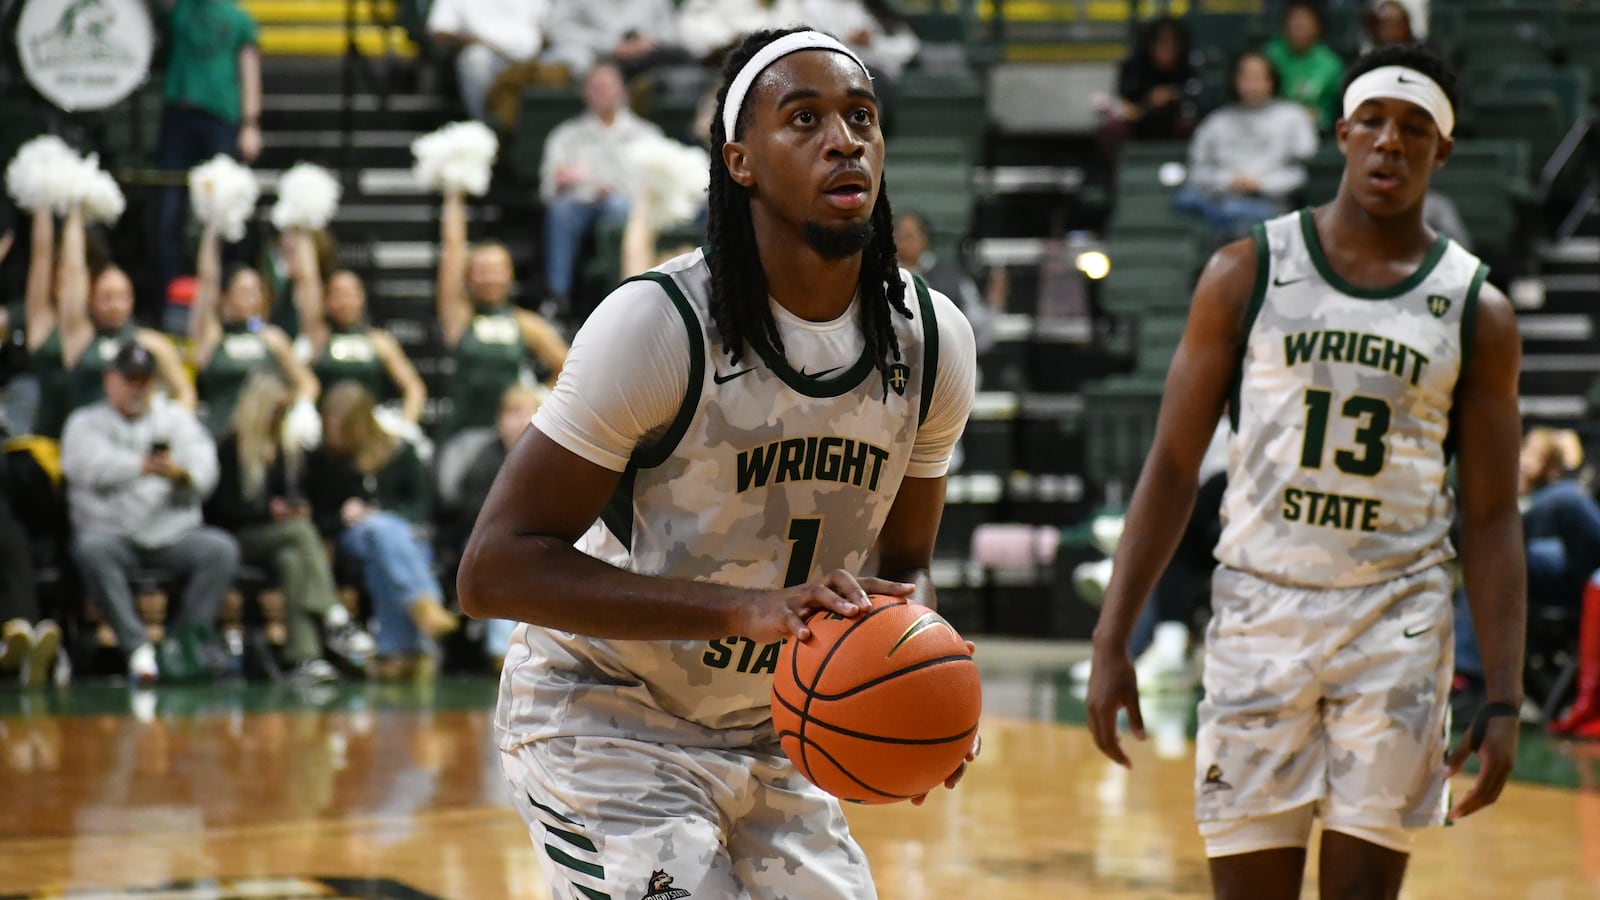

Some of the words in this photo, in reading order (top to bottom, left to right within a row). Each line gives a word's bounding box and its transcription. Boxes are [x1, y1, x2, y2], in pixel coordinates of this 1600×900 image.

[1284, 330, 1430, 387] WRIGHT
[1300, 388, 1391, 477] 13
[736, 435, 890, 494] WRIGHT
[1282, 487, 1382, 532] STATE
[783, 517, 823, 589] 1
[702, 636, 788, 674] STA
